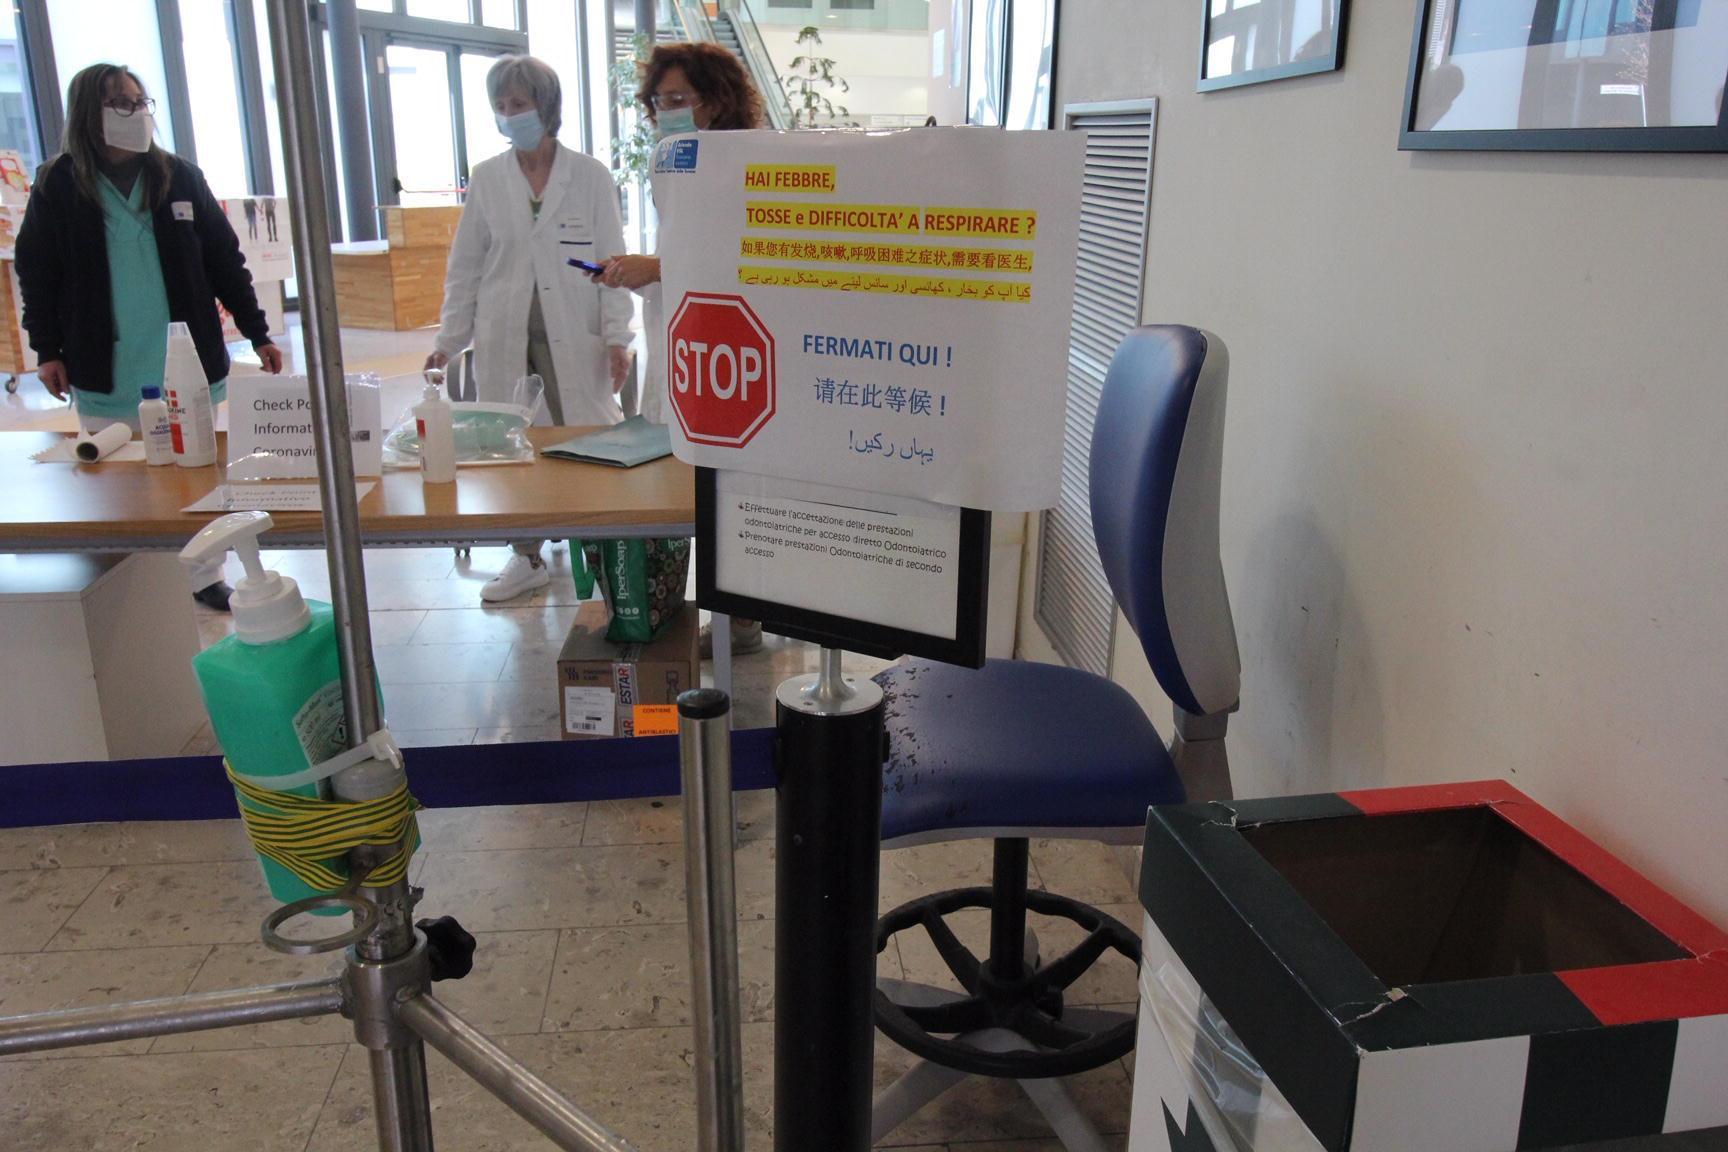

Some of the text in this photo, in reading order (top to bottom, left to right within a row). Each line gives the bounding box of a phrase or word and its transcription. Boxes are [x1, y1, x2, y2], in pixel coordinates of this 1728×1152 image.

[745, 171, 835, 192] HAI FEBBRE,
[746, 208, 791, 225] TOSSE
[795, 212, 804, 225] e
[907, 213, 920, 230] A
[924, 214, 1020, 234] RESPIRARE
[1026, 216, 1036, 234] ?
[803, 334, 892, 361] FERMATI
[899, 343, 938, 367] QUI
[674, 338, 762, 401] STOP
[253, 398, 293, 411] Check
[253, 423, 312, 435] Informat
[253, 445, 316, 457] Coronavi
[744, 502, 787, 517] Effettuare
[845, 519, 866, 530] delle
[867, 523, 914, 537] prestazioni
[744, 518, 947, 558] odontoiatriche per accesso diretto Odontoiatrico
[744, 545, 775, 558] accesso
[744, 531, 943, 574] Prenotare prestazioni Odontoiatriche di secondo
[615, 540, 629, 600] IperSoap
[617, 667, 632, 705] ESTAR
